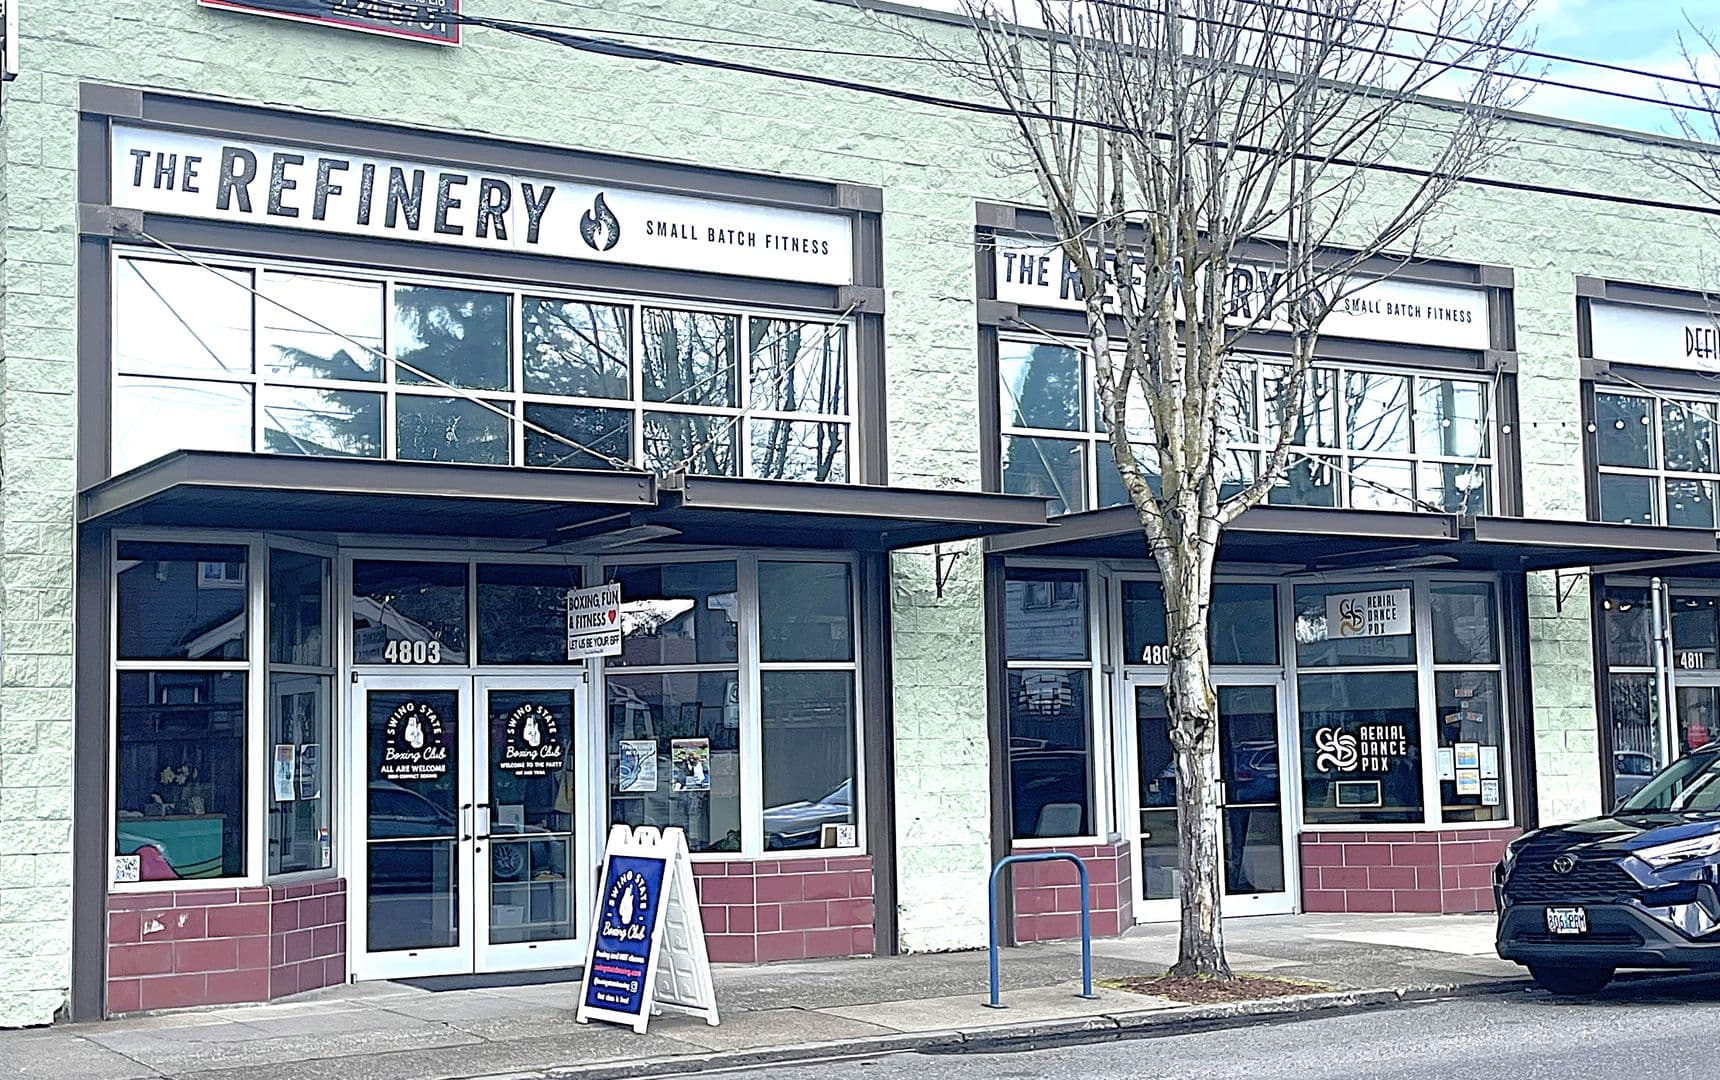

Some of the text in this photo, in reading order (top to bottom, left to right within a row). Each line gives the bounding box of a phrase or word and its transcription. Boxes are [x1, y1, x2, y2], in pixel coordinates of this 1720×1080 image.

[130, 145, 555, 244] THE REFINERY
[646, 220, 829, 256] SMALL BATCH FITNESS
[1003, 252, 1050, 287] THE
[1344, 298, 1472, 323] SMALL BATCH FITNESS
[1685, 326, 1720, 360] DEFI
[569, 590, 619, 611] BOXING, FUN
[1367, 594, 1396, 608] AERIAL
[569, 612, 606, 630] & FITNESS
[1367, 608, 1396, 622] DANCE
[1368, 622, 1385, 635] PDX
[569, 639, 577, 650] LET
[578, 638, 585, 649] US
[586, 637, 593, 648] BE
[594, 635, 609, 647] YOUR
[385, 640, 441, 664] 4803
[1142, 645, 1168, 665] 480
[1680, 652, 1704, 670] 4811
[387, 702, 442, 736] SWING STATE
[507, 704, 557, 735] SWING STATE
[1360, 725, 1406, 740] AERIAL
[386, 746, 446, 763] Boxing Club
[506, 745, 561, 760] Boxing Club
[1360, 740, 1407, 756] DANCE
[381, 764, 446, 773] ALL ARE WELCOME
[1362, 756, 1389, 772] PDX
[602, 921, 646, 941] Boxing Club
